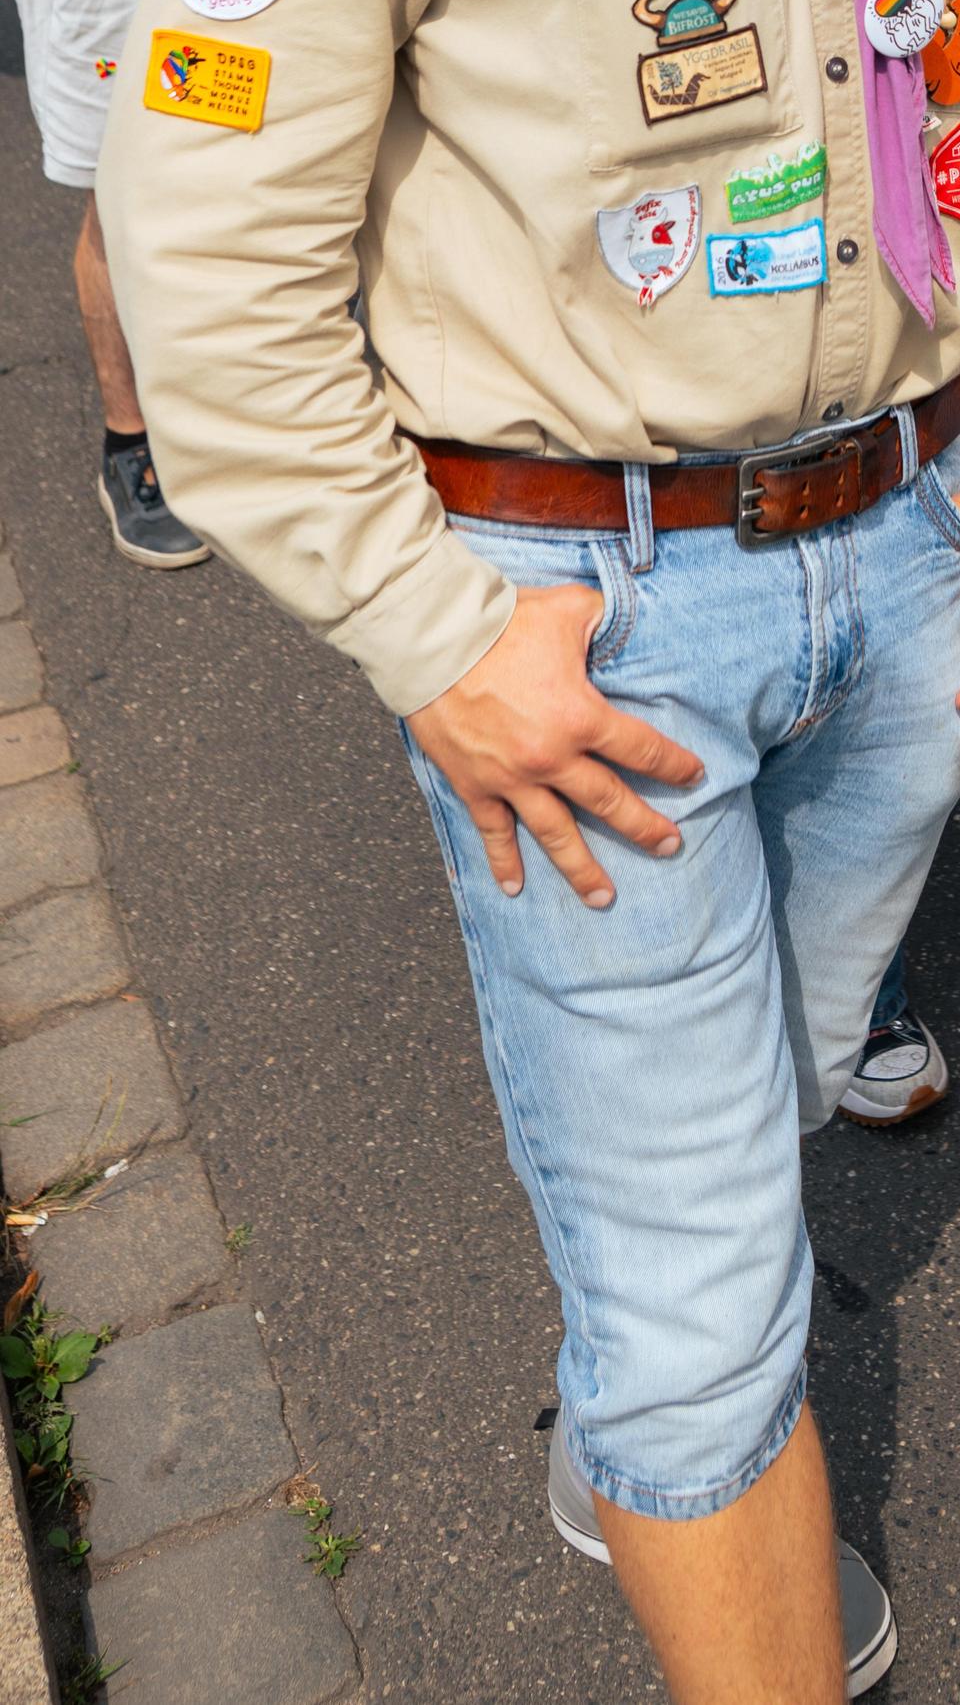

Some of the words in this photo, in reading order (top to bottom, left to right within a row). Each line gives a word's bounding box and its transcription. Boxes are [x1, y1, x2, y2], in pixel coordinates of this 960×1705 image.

[672, 10, 686, 21] WE
[667, 13, 716, 36] BIFROST
[217, 52, 256, 71] DPSG
[215, 69, 253, 84] STAMM
[214, 79, 252, 95] THOMAS
